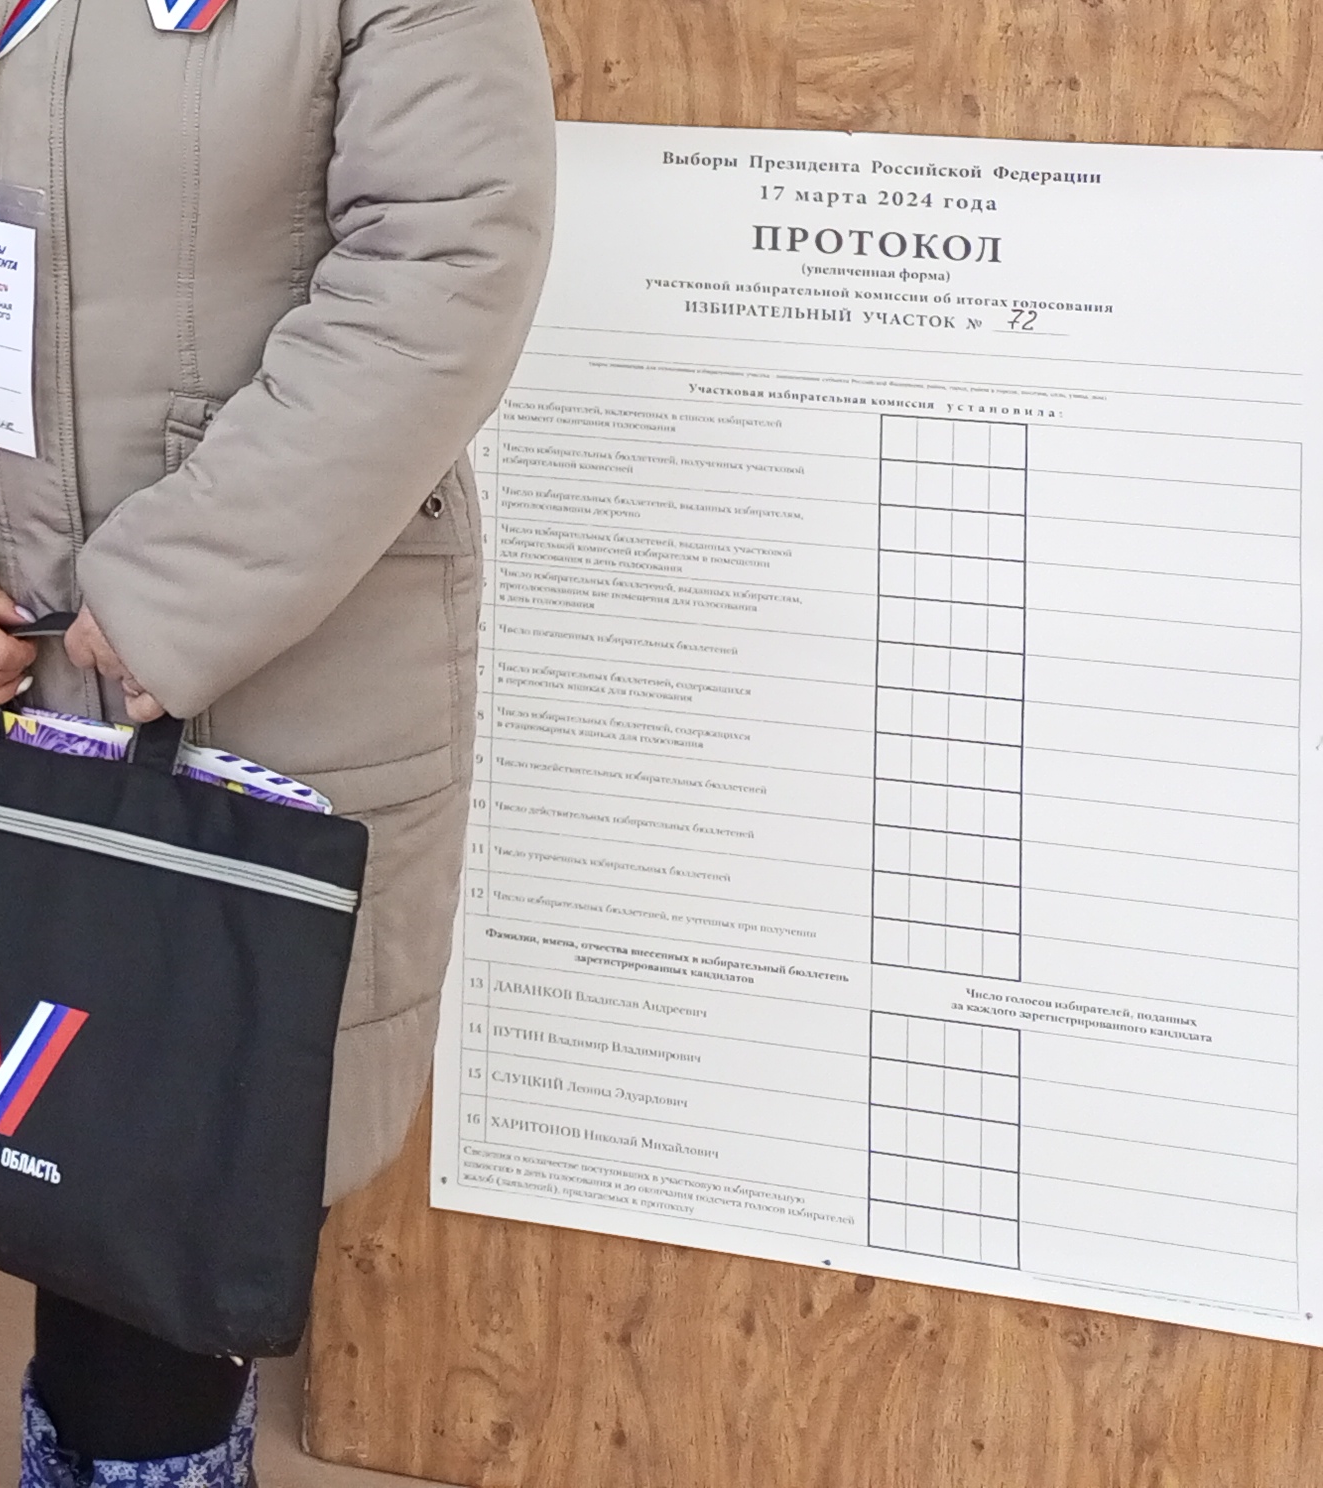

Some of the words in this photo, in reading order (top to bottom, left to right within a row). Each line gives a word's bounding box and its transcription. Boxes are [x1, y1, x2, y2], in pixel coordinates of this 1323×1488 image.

[662, 151, 737, 170] Выборы
[749, 155, 860, 173] Президента
[871, 160, 981, 178] Российской
[993, 166, 1101, 185] Федерации
[761, 185, 785, 200] 17
[795, 190, 867, 207] марта
[877, 190, 932, 208] 2024
[943, 197, 997, 213] года
[752, 225, 1001, 262] ПРОТОКОЛ
[801, 264, 895, 278] (увеличенная
[898, 268, 950, 283] форма)
[645, 278, 730, 291] участковой
[735, 282, 849, 298] избирательной
[854, 290, 928, 302] комиссии
[933, 292, 951, 303] об
[956, 296, 1007, 307] итогах
[1010, 300, 1113, 314] голосования
[685, 300, 852, 323] ИЗБИРАТЕЛЬНЫЙ
[863, 312, 955, 329] УЧАСТОК
[1007, 309, 1039, 331] 72
[688, 383, 764, 399] Участковая
[768, 390, 867, 405] избирательная
[871, 398, 934, 409] комиссия
[470, 977, 484, 990] 13
[493, 980, 572, 1000] ДАВАНКОВ
[965, 987, 1003, 1002] Число
[1005, 995, 1052, 1007] голосов
[1137, 1012, 1197, 1027] поданных
[966, 1004, 1017, 1017] каждого
[468, 1022, 482, 1035] 14
[493, 1025, 544, 1042] ПУТИН
[547, 1032, 609, 1053] Владимир
[467, 1068, 482, 1080] 15
[491, 1070, 563, 1090] СЛУЦКИЙ
[614, 1087, 687, 1108] Эдуардович
[466, 1113, 481, 1126] 16
[491, 1116, 581, 1138] ХАРИТОНОВ
[583, 1128, 637, 1147] Николай
[641, 1137, 719, 1159] Михайлович
[1, 1147, 61, 1184] ОБЛАСТЬ
